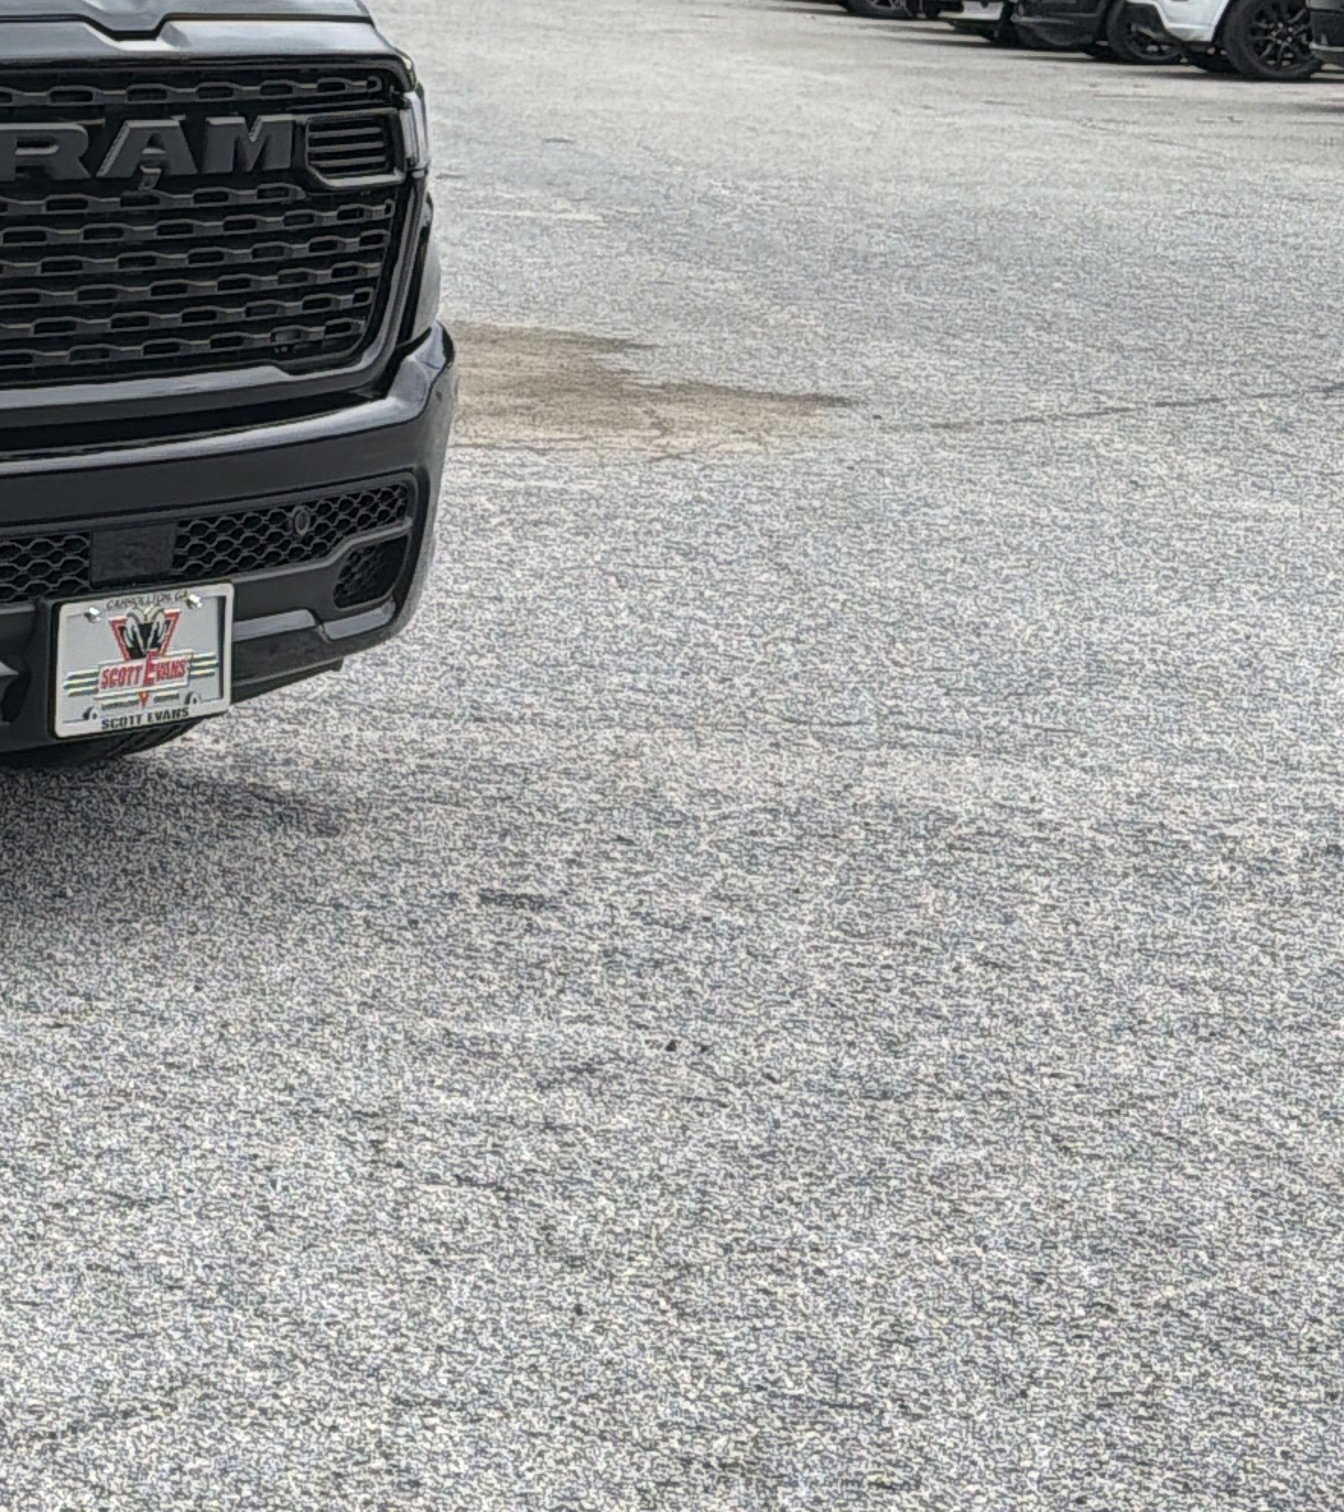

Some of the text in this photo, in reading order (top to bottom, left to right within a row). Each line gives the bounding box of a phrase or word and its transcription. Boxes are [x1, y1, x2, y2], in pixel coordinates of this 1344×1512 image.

[100, 648, 187, 690] SCOTT EVANS
[100, 706, 190, 731] SCOTT EVANS
